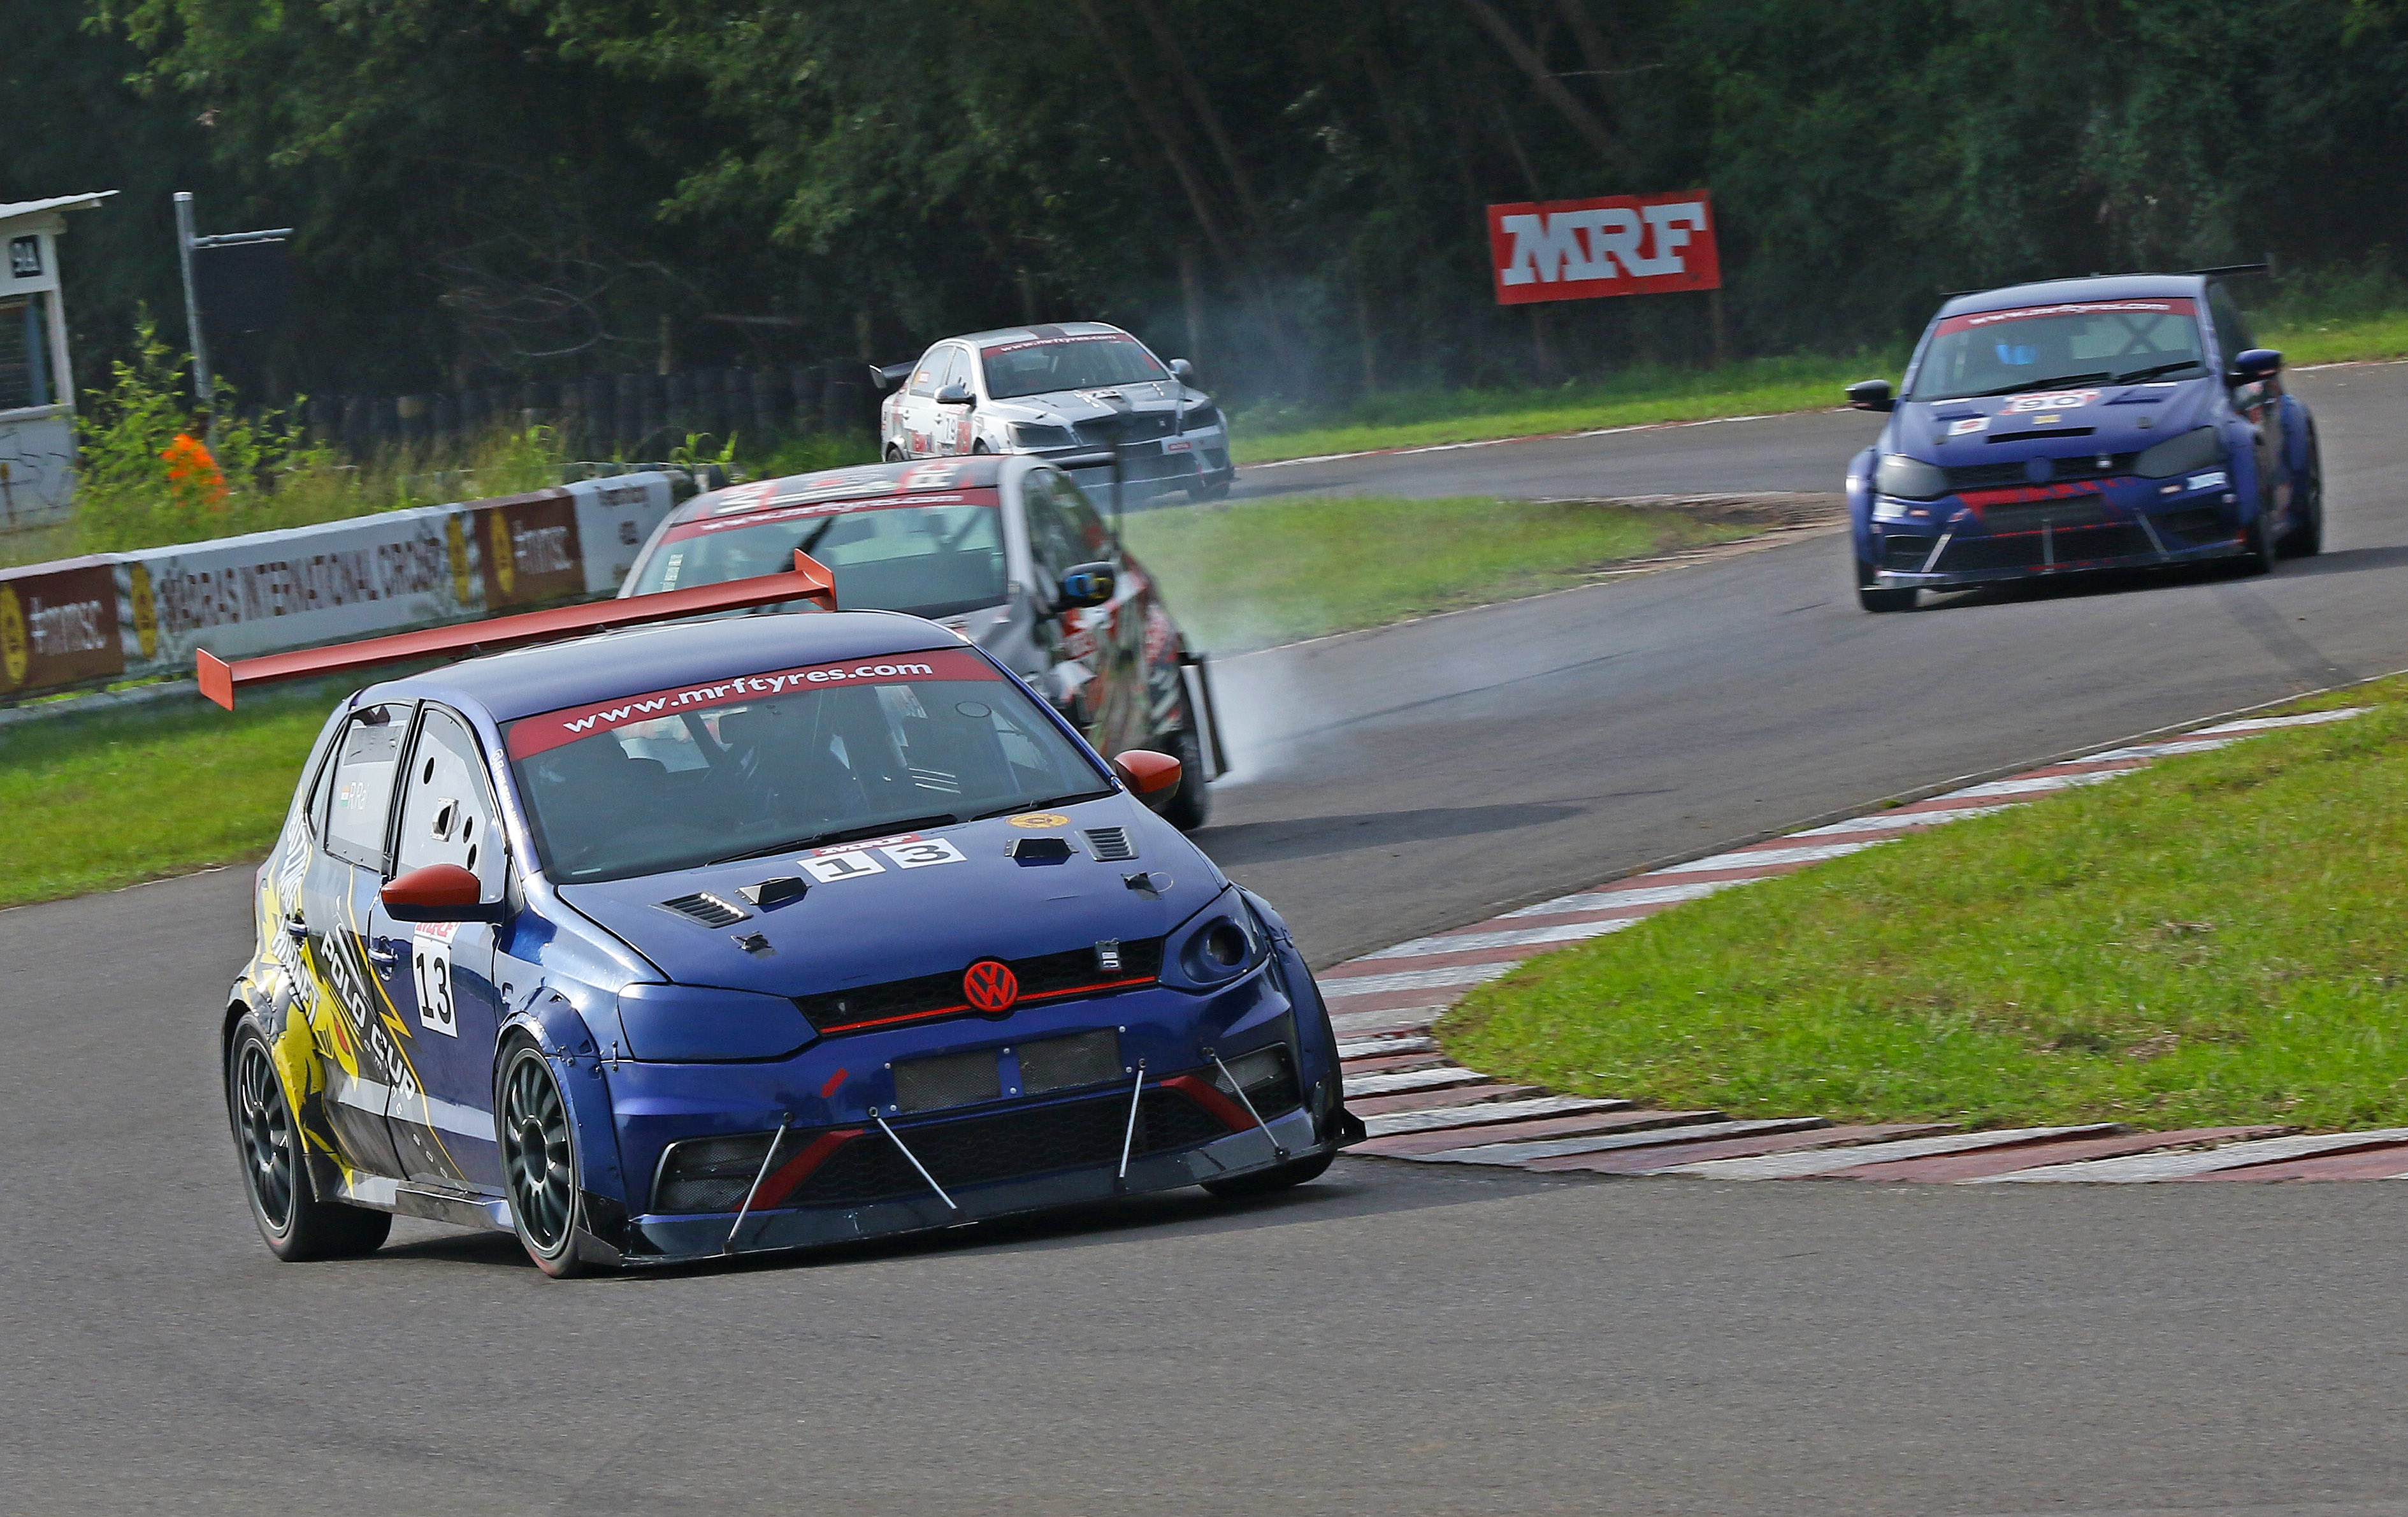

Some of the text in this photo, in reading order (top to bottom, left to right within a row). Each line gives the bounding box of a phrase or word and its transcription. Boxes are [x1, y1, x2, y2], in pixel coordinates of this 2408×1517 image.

[1501, 201, 1706, 286] MRF
[1000, 335, 1117, 352] www.mrftyres.com
[563, 661, 934, 733] www.mrftyres.com
[816, 845, 953, 878] 13
[818, 834, 913, 855] MRF
[321, 931, 417, 1101] POLO CUP
[416, 952, 451, 1025] 13
[964, 961, 1018, 1012] VW
